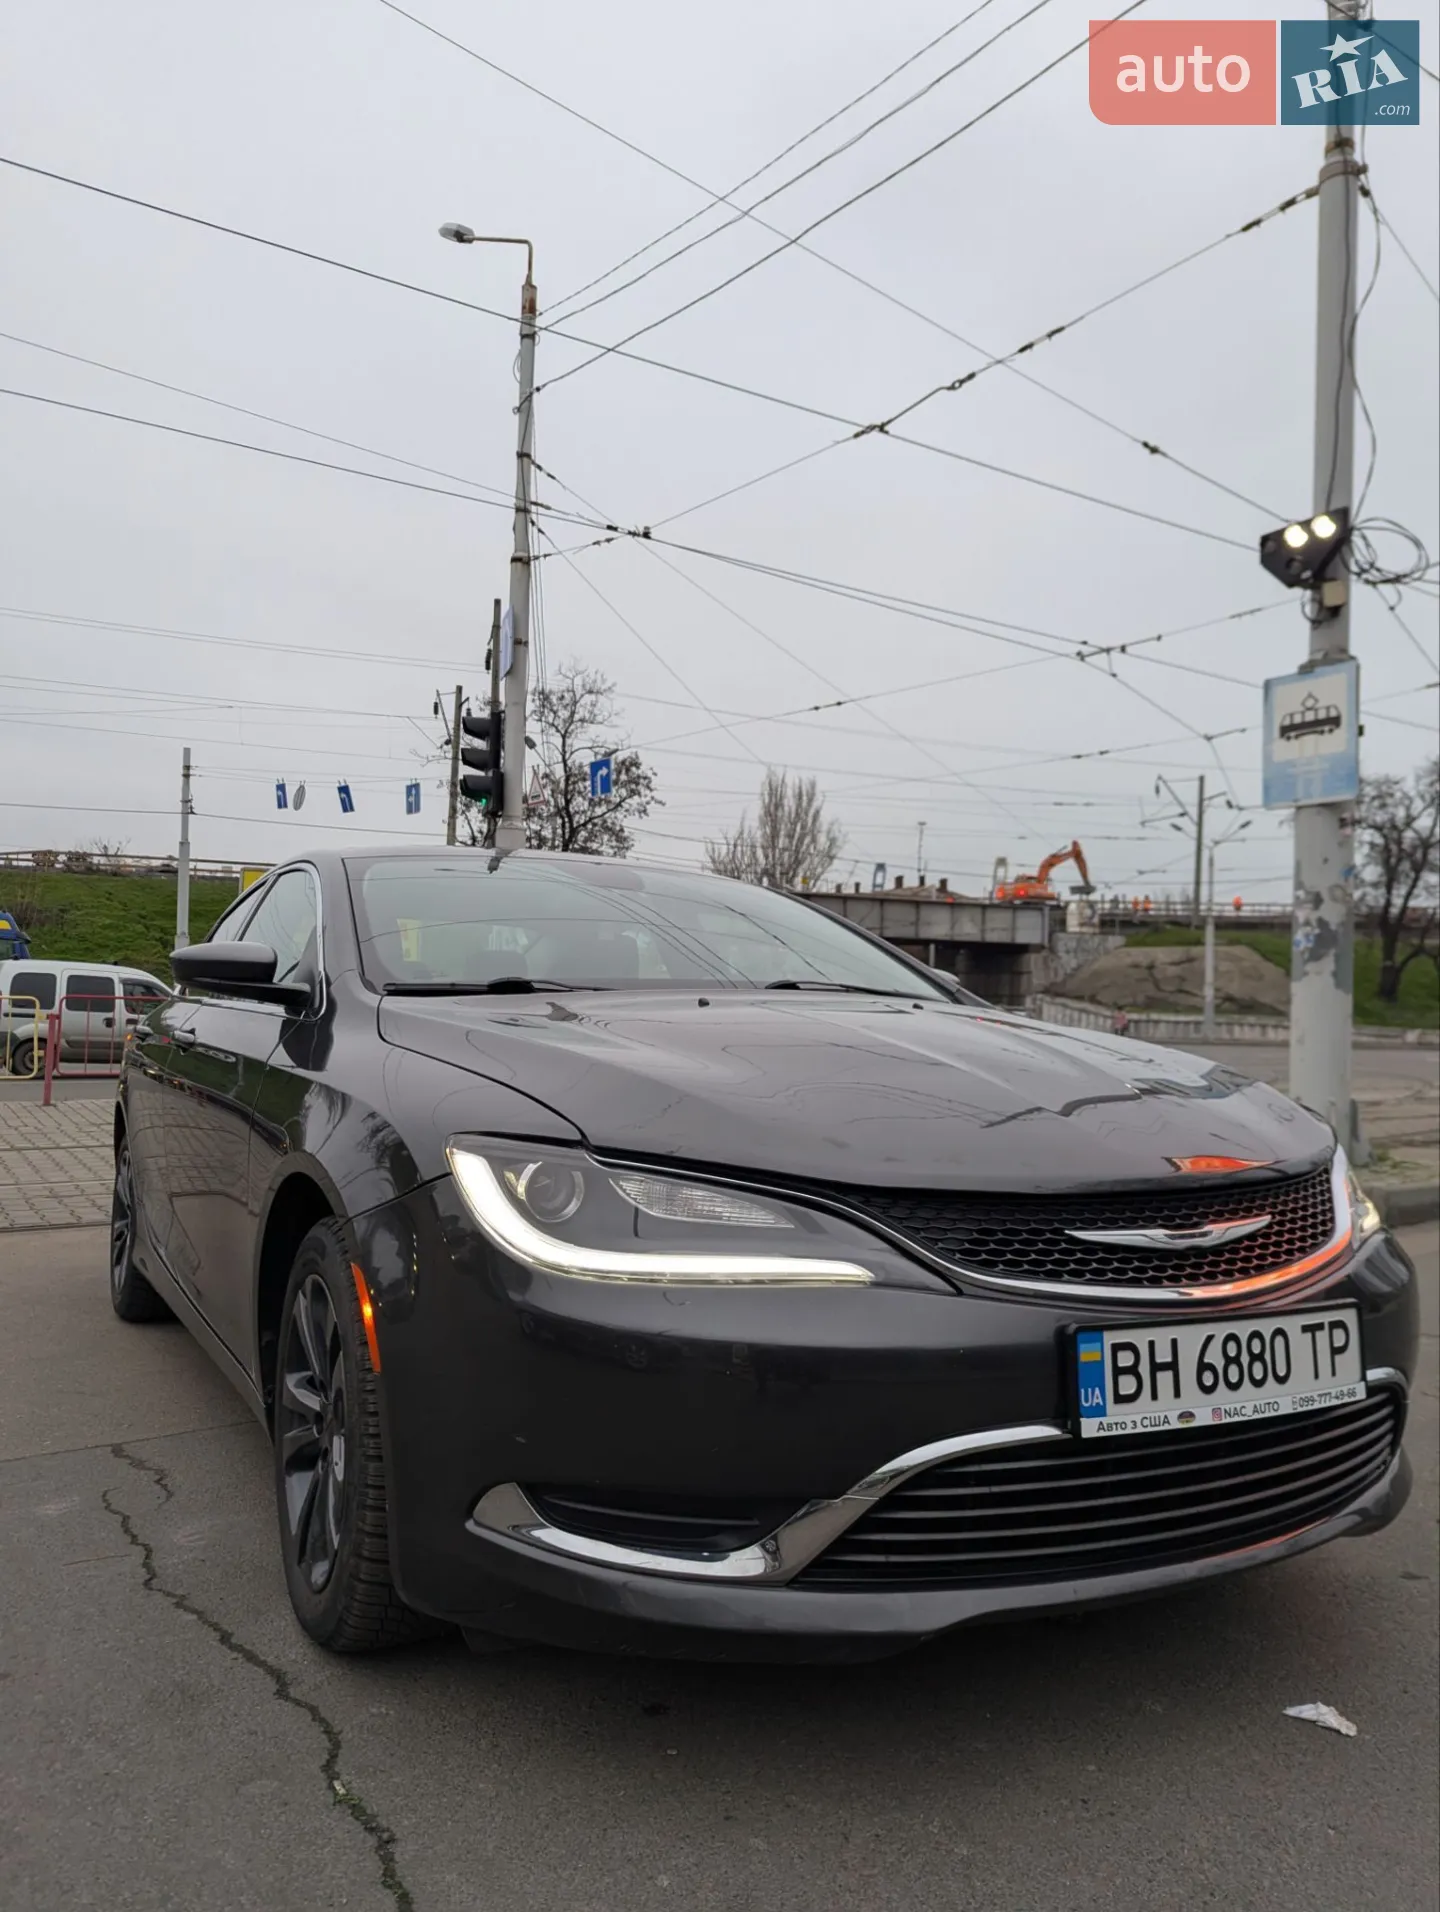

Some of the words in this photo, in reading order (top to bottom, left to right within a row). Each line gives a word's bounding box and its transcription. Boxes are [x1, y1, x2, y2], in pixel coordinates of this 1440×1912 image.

[1110, 1337, 1182, 1405] BH
[1196, 1327, 1292, 1395] 6880
[1301, 1319, 1350, 1380] TP
[1081, 1387, 1103, 1407] UA
[1224, 1401, 1280, 1419] NAC_AUTO
[1096, 1419, 1129, 1433] Авто
[1131, 1420, 1137, 1430] з
[1140, 1414, 1171, 1428] США
